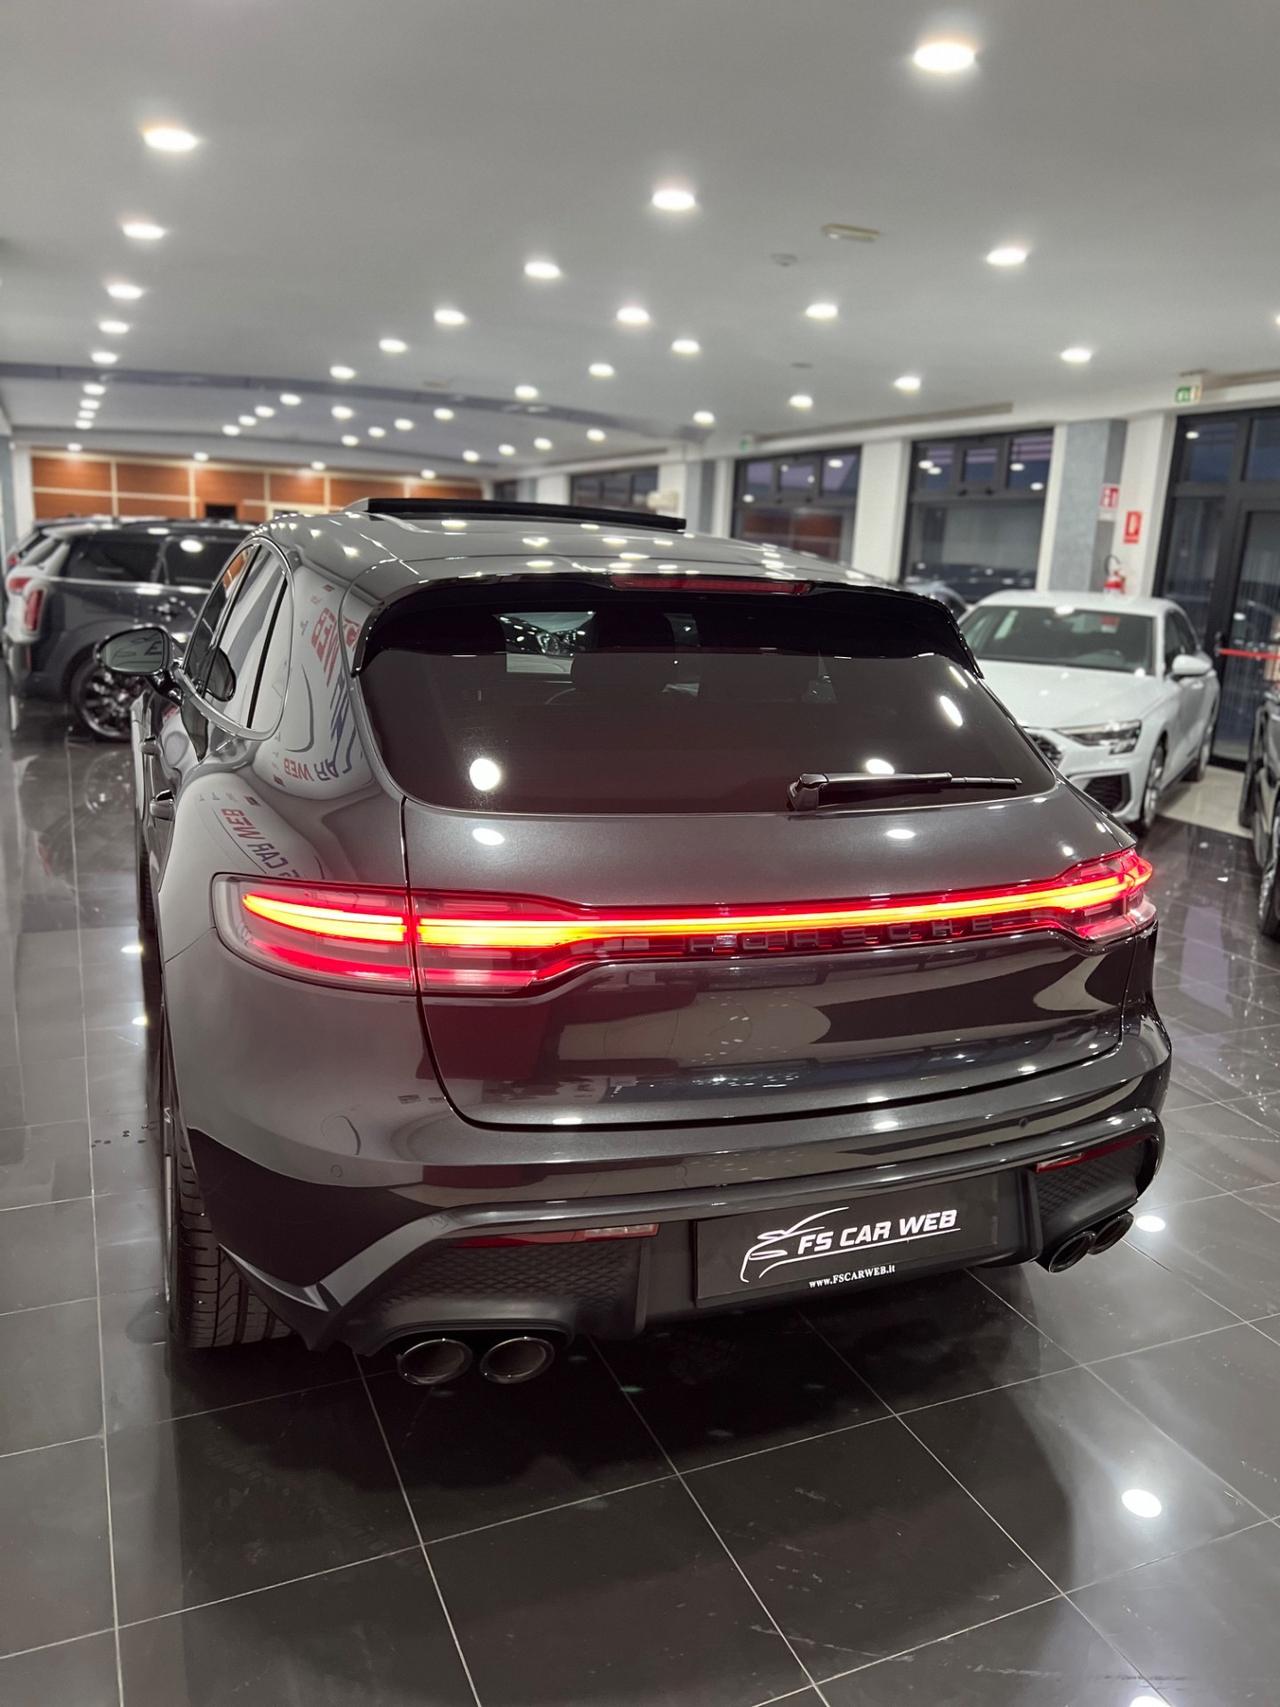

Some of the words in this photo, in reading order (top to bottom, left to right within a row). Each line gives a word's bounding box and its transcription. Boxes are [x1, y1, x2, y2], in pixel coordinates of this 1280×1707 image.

[797, 1231, 834, 1255] FS
[839, 1221, 892, 1247] CAR
[899, 1209, 957, 1236] WEB
[808, 1265, 896, 1288] www.FSCARWEB.it
